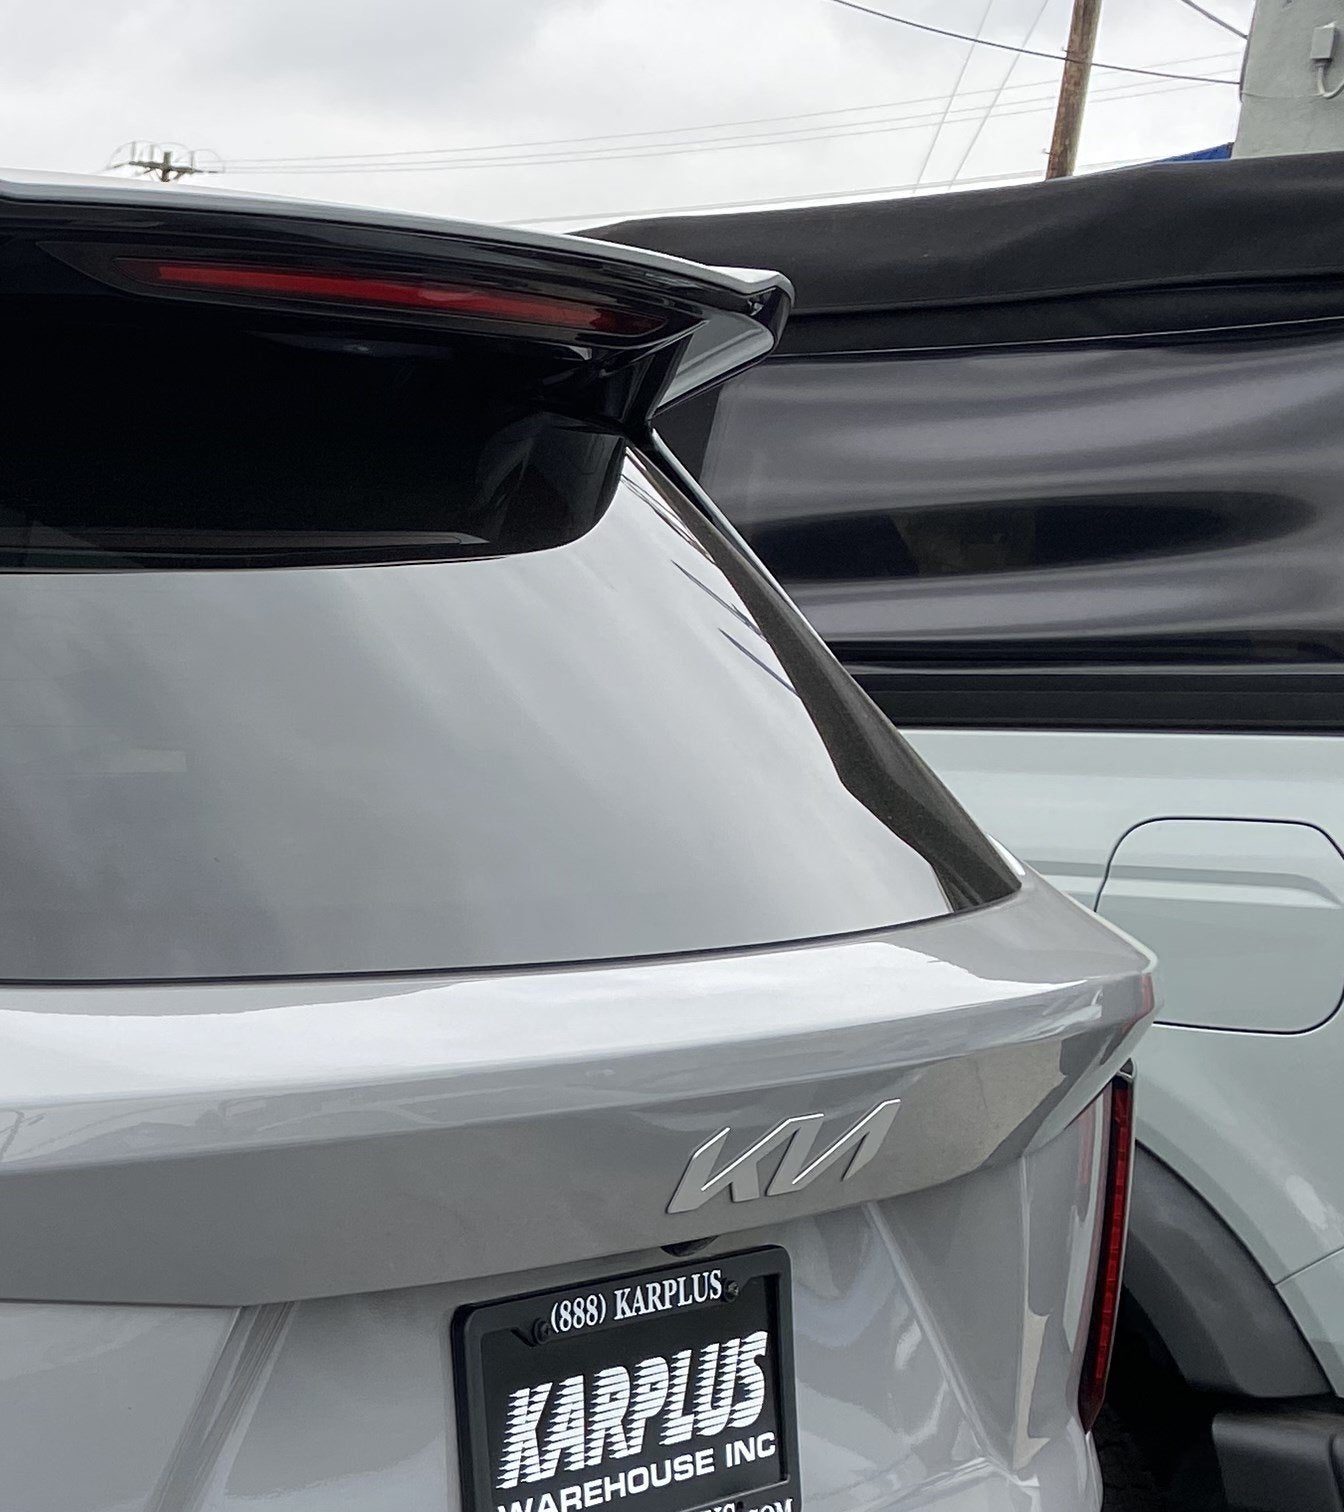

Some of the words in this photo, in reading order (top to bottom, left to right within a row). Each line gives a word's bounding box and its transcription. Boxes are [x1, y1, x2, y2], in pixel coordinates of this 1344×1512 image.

[550, 1294, 608, 1334] (888)
[614, 1269, 723, 1322] KARPLUS
[496, 1331, 769, 1490] KARPLUS
[725, 1431, 777, 1468] INC
